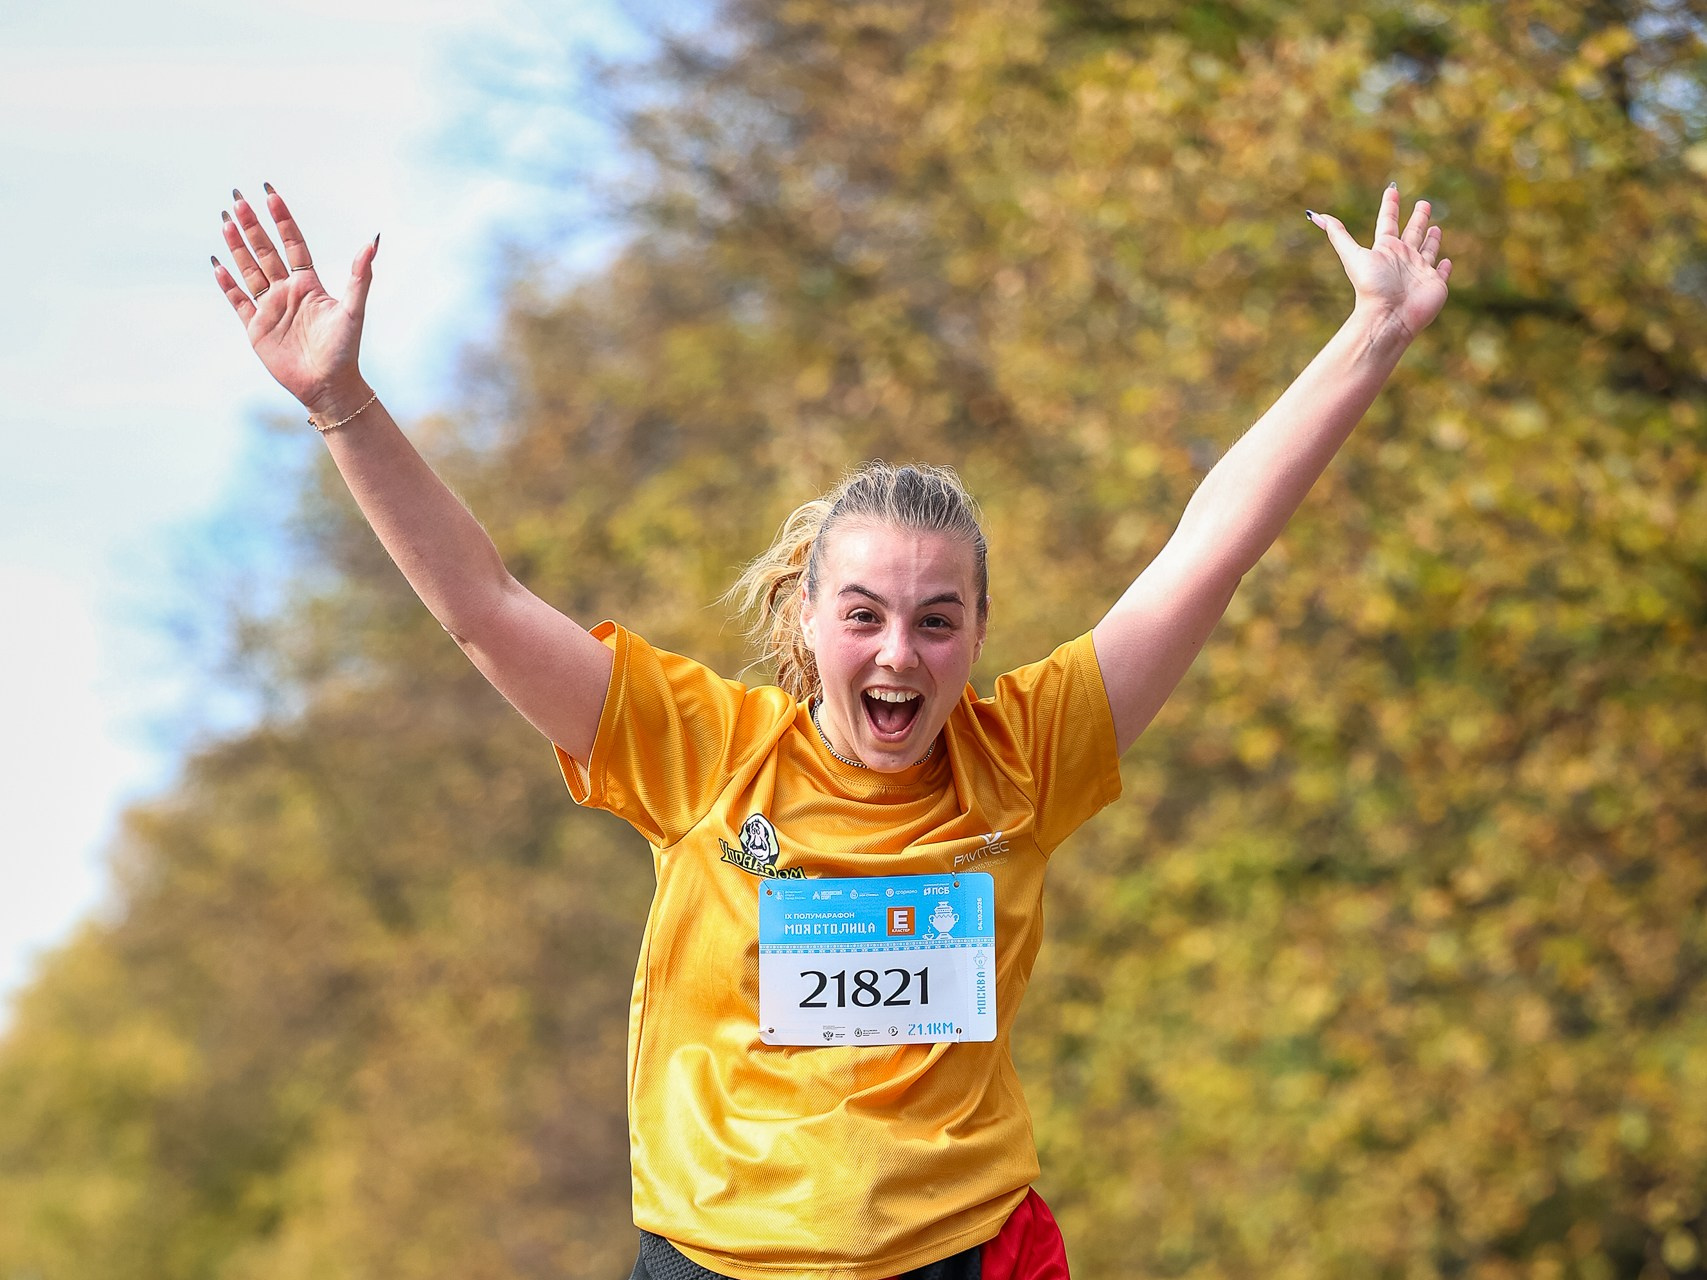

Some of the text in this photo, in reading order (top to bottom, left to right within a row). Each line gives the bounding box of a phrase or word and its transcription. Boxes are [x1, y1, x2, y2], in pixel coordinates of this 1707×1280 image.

[931, 886, 950, 895] ПСБ
[784, 912, 855, 920] IX ПОЛУМАРАФОН
[784, 923, 876, 936] МОЯ СТОЛИЦА
[798, 966, 929, 1008] 21821
[977, 971, 987, 1015] МОСКВА
